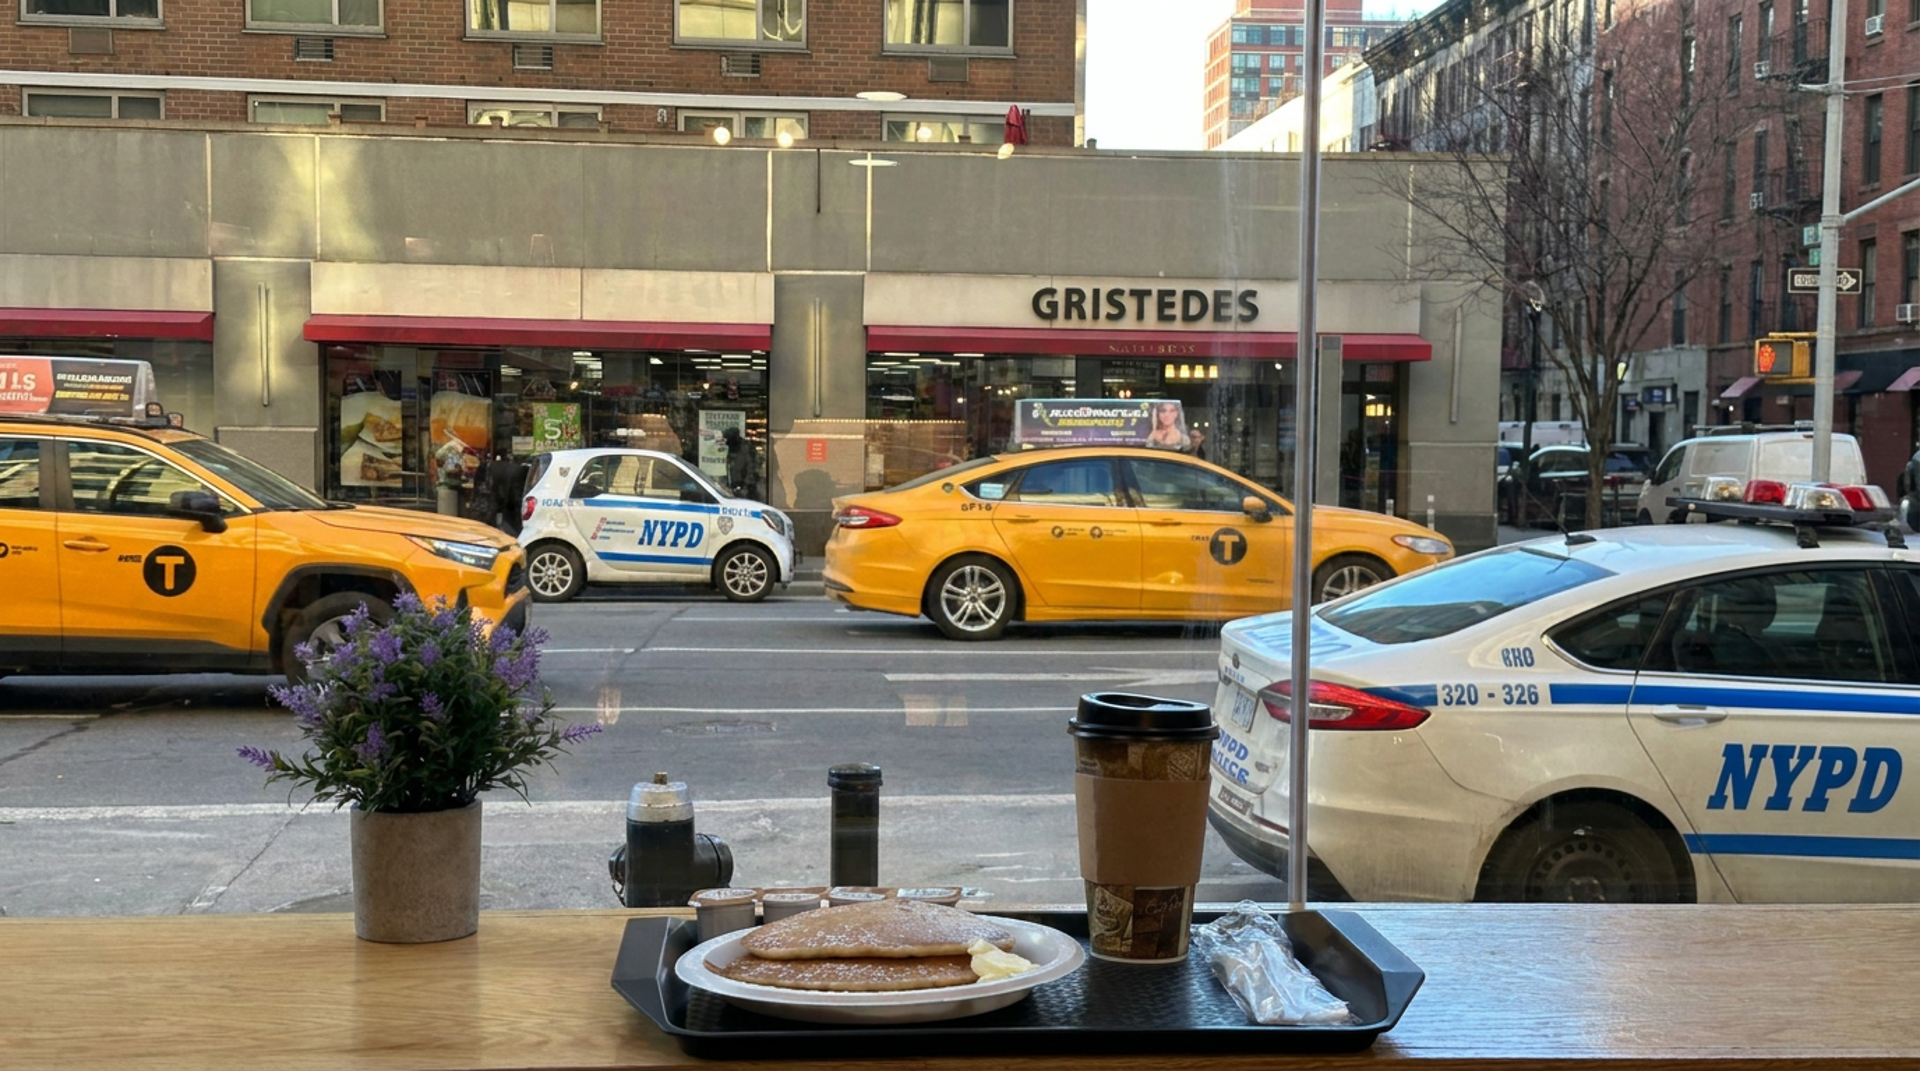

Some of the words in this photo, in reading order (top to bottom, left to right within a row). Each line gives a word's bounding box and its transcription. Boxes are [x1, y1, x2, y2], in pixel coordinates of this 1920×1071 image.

[1032, 287, 1259, 322] GRISTEDES
[638, 519, 704, 548] NYPD
[1218, 534, 1240, 561] T
[155, 555, 185, 590] T
[1441, 683, 1479, 706] 320
[1502, 683, 1539, 706] 326
[1707, 743, 1902, 813] NYPD
